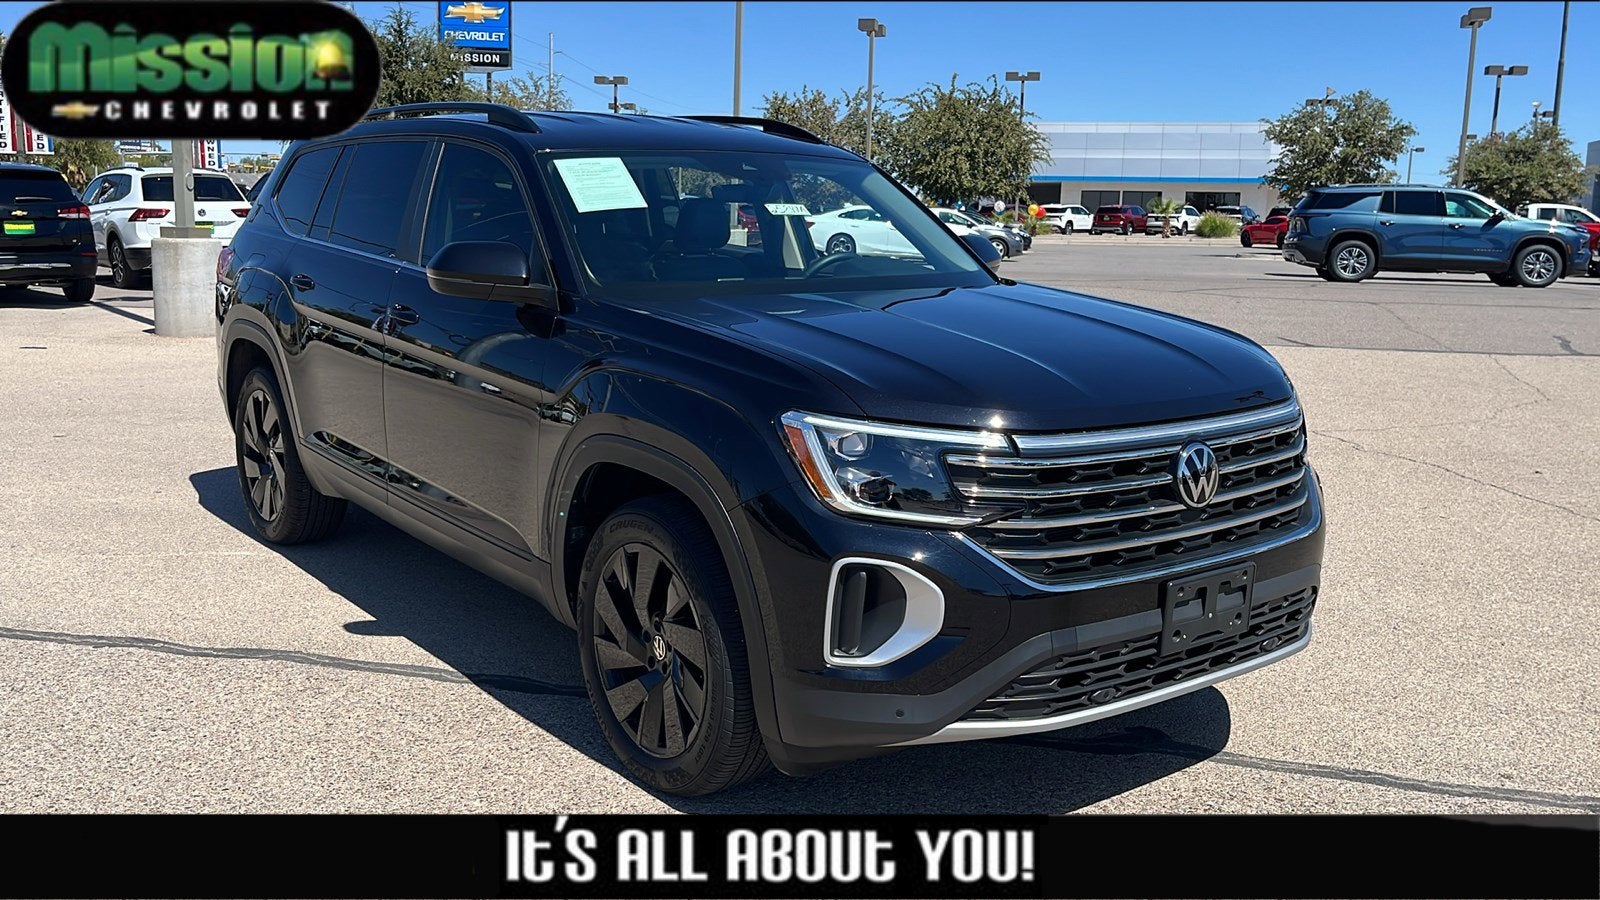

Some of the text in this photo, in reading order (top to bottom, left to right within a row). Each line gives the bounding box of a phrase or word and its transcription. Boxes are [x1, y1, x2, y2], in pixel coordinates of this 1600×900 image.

[444, 30, 505, 42] CHEVROLET
[450, 53, 500, 63] MISSION
[609, 519, 655, 534] CRUGEN
